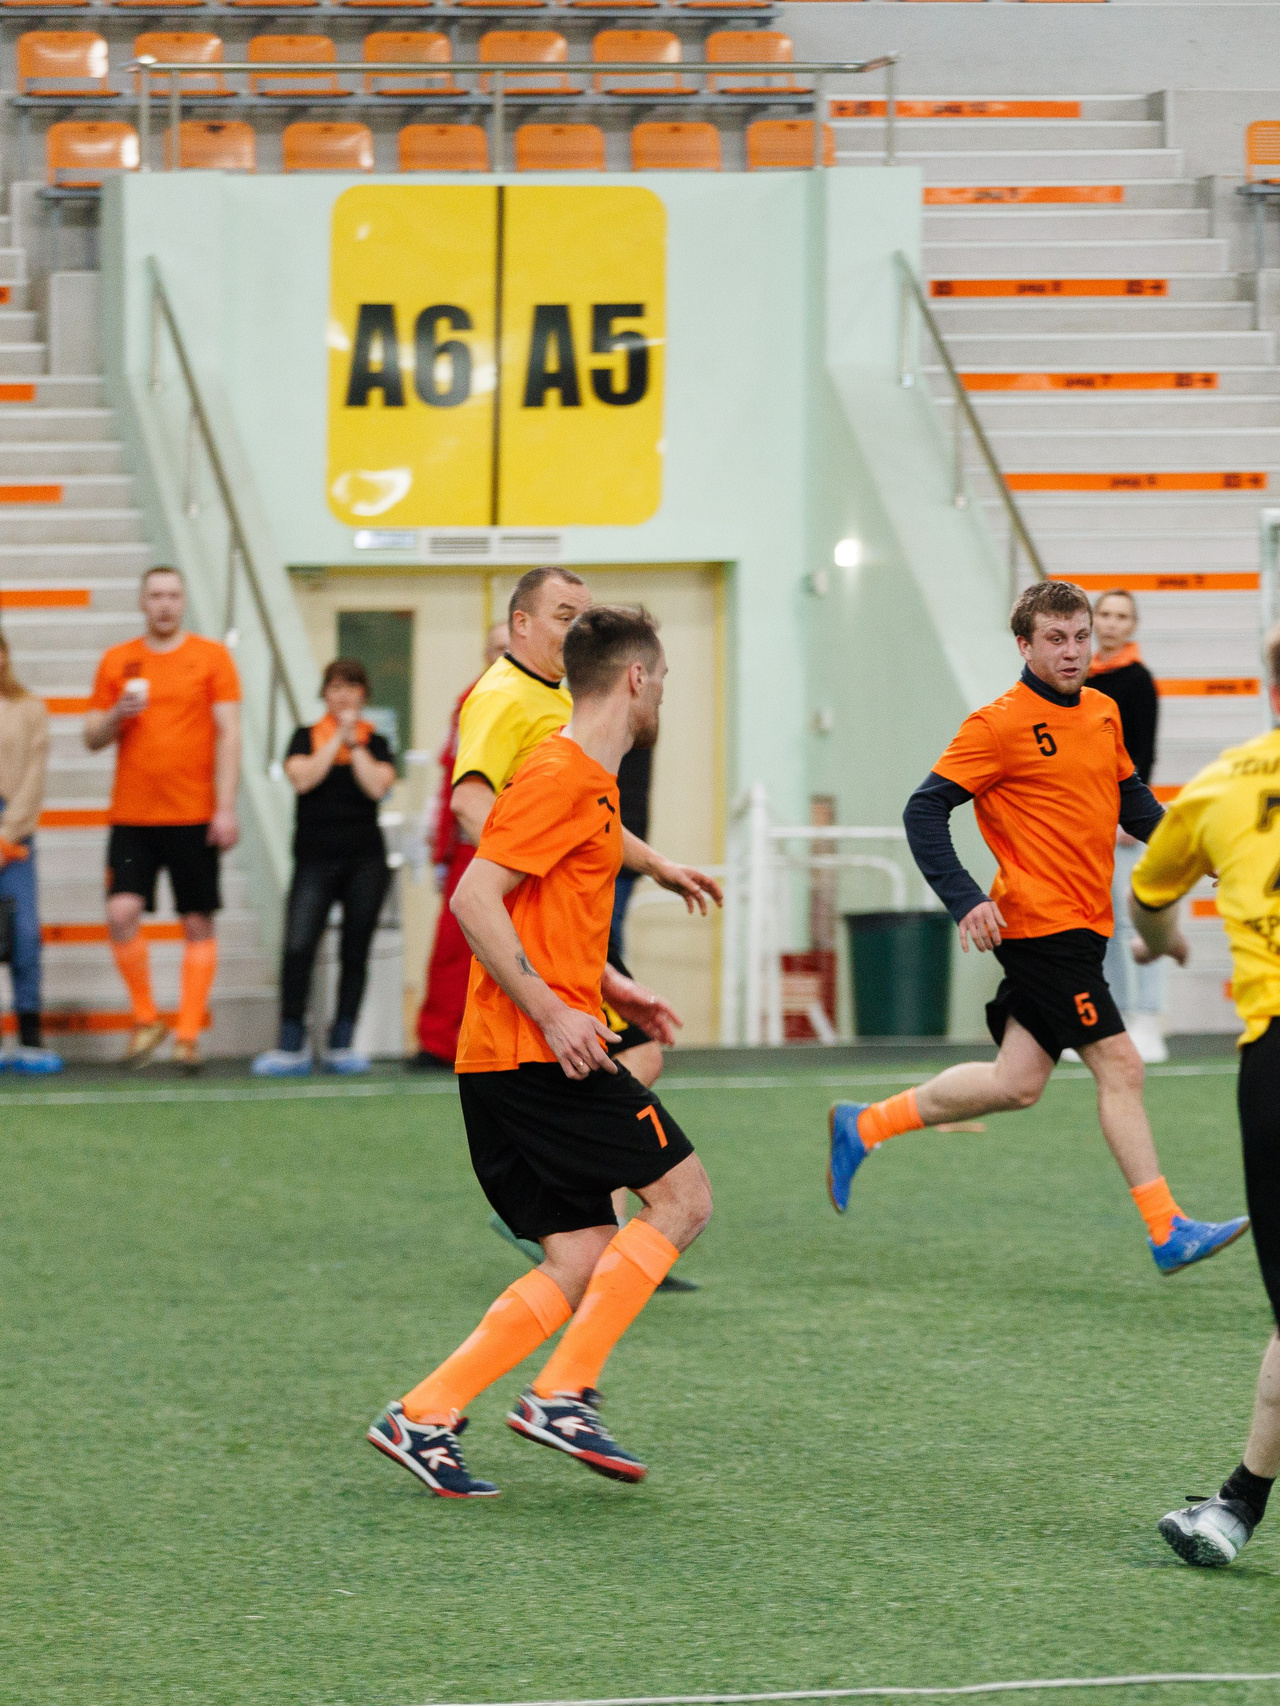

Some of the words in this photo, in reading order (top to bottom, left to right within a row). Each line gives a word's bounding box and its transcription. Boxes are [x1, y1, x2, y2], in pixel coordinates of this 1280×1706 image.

[345, 303, 475, 409] A6
[523, 303, 651, 408] A5
[1032, 722, 1058, 757] 5
[1073, 991, 1099, 1027] 5
[635, 1104, 669, 1149] 7
